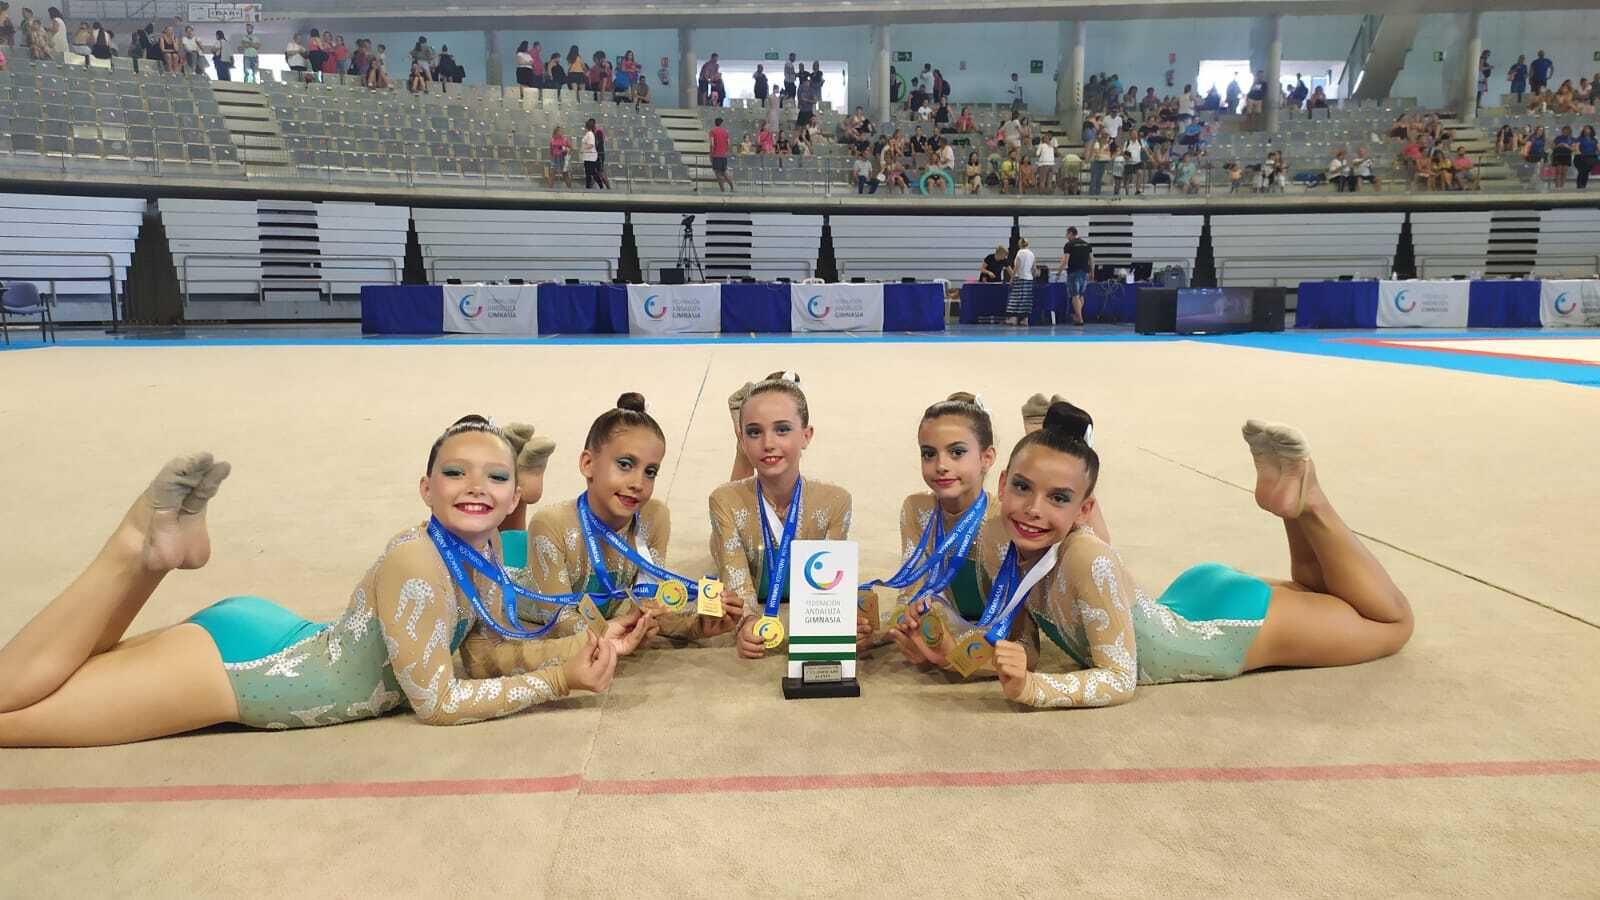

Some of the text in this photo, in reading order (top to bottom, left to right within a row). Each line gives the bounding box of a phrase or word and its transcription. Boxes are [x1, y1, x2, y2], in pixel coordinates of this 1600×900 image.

[805, 599, 841, 607] FEDERACIÓN
[805, 607, 841, 615] ANDALUZA
[805, 616, 841, 624] GIMNASIA
